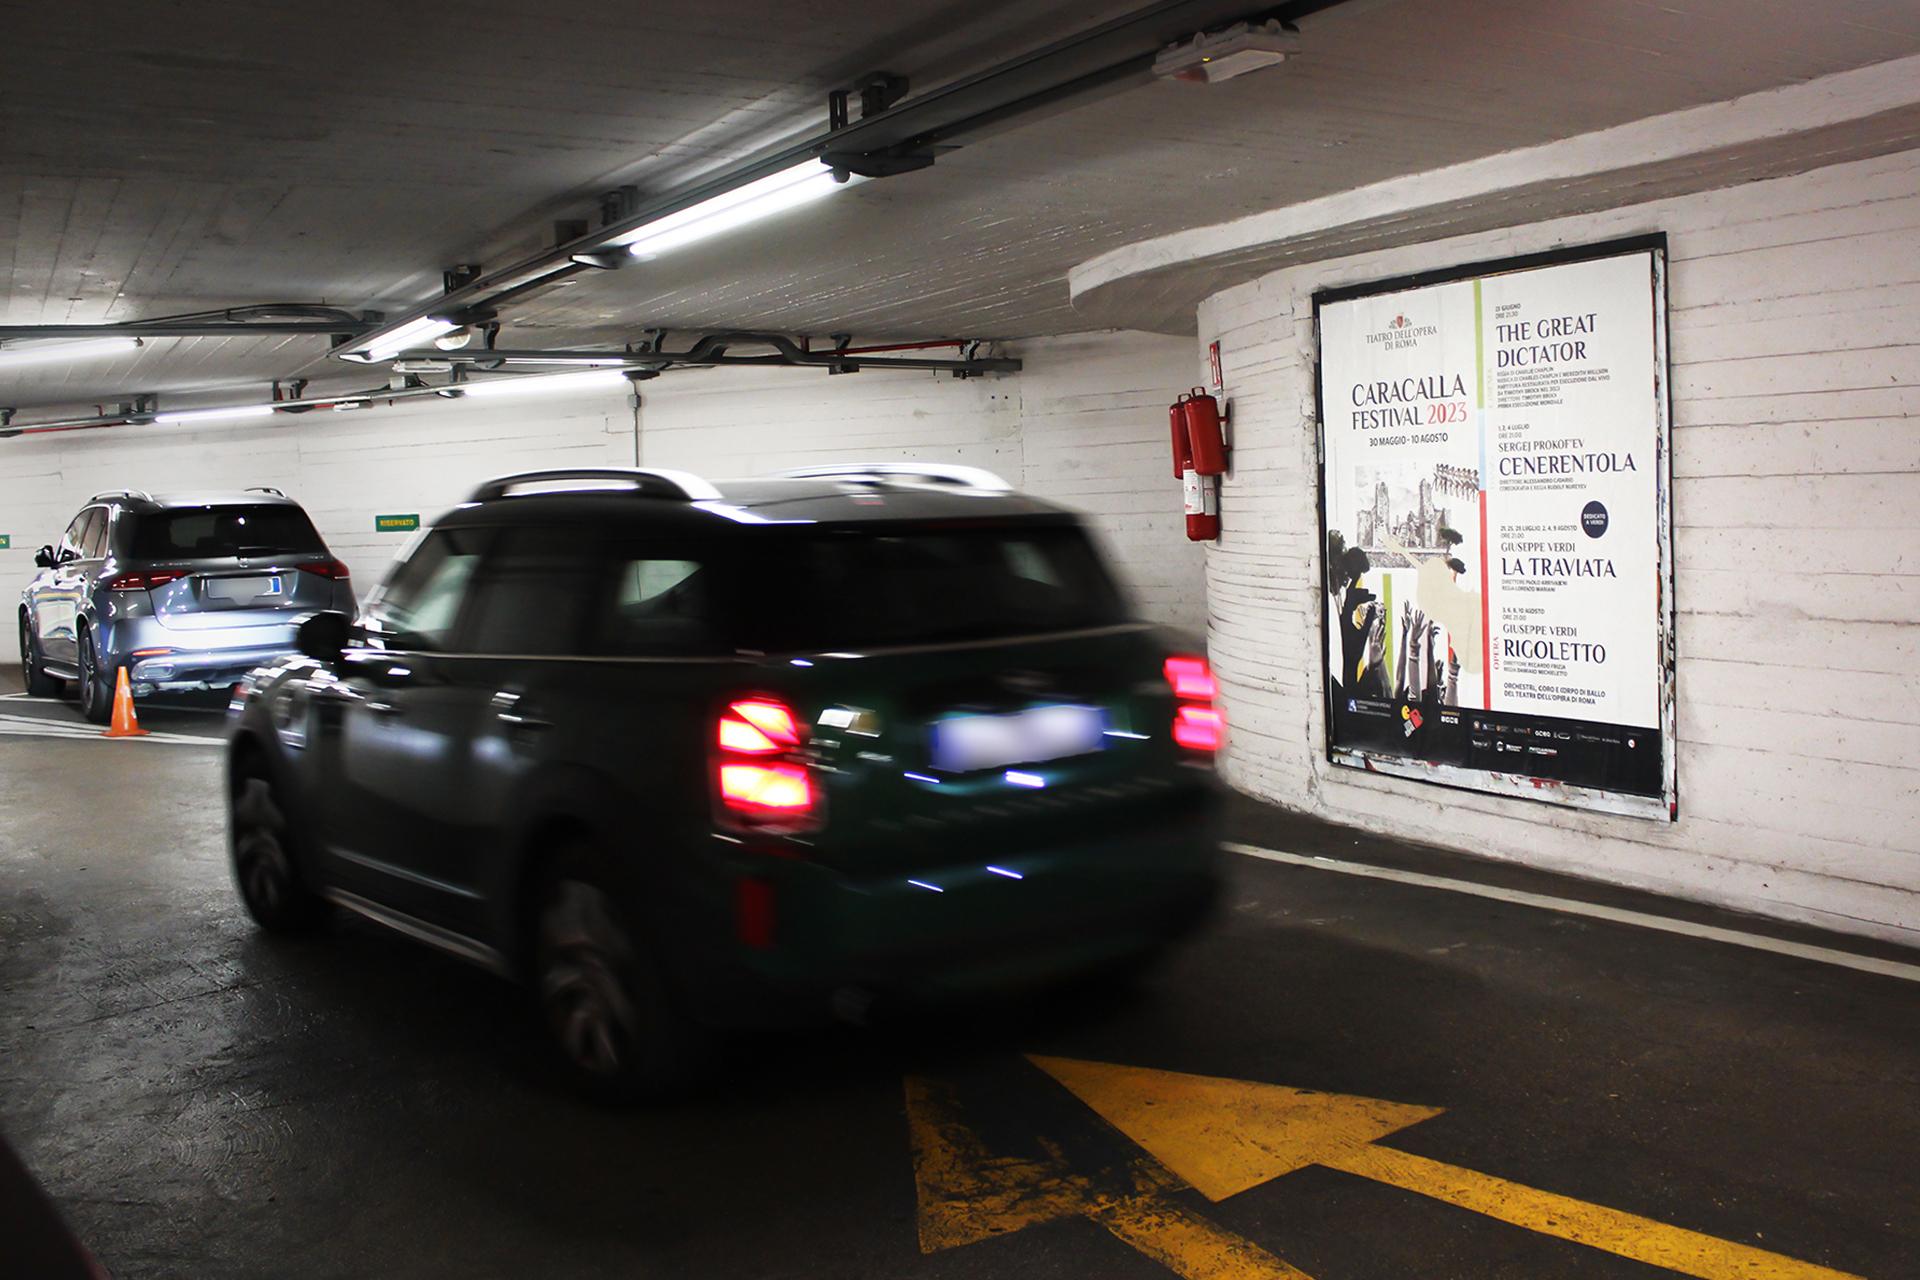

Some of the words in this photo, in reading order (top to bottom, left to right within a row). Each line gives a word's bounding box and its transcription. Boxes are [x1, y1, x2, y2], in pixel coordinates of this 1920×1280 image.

[1496, 322, 1531, 343] THE
[1537, 314, 1597, 338] GREAT
[1366, 332, 1393, 344] TEATRO
[1384, 342, 1393, 351] DI
[1395, 338, 1418, 349] ROMA
[1497, 341, 1586, 368] DICTATOR
[1352, 374, 1466, 406] CARACALLA
[1352, 406, 1424, 430] FESTIVAL
[1428, 402, 1467, 424] 2023
[1370, 438, 1378, 447] 30
[1380, 436, 1406, 446] MAGGIO
[1412, 435, 1419, 444] 10
[1420, 432, 1448, 442] AGOSTO
[1499, 440, 1532, 452] SERGEJ
[1534, 438, 1584, 451] PROKOF'EV
[1500, 453, 1636, 476] CENERENTOLA
[1501, 542, 1546, 552] GIUSEPPE
[1548, 542, 1576, 552] VERDI
[1502, 558, 1524, 576] LA
[1528, 558, 1616, 578] TRAVIATA
[1503, 624, 1546, 636] GIUSEPPE
[1549, 626, 1577, 636] VERDI
[1504, 639, 1606, 664] RIGOLETTO
[1560, 686, 1579, 695] CORPO
